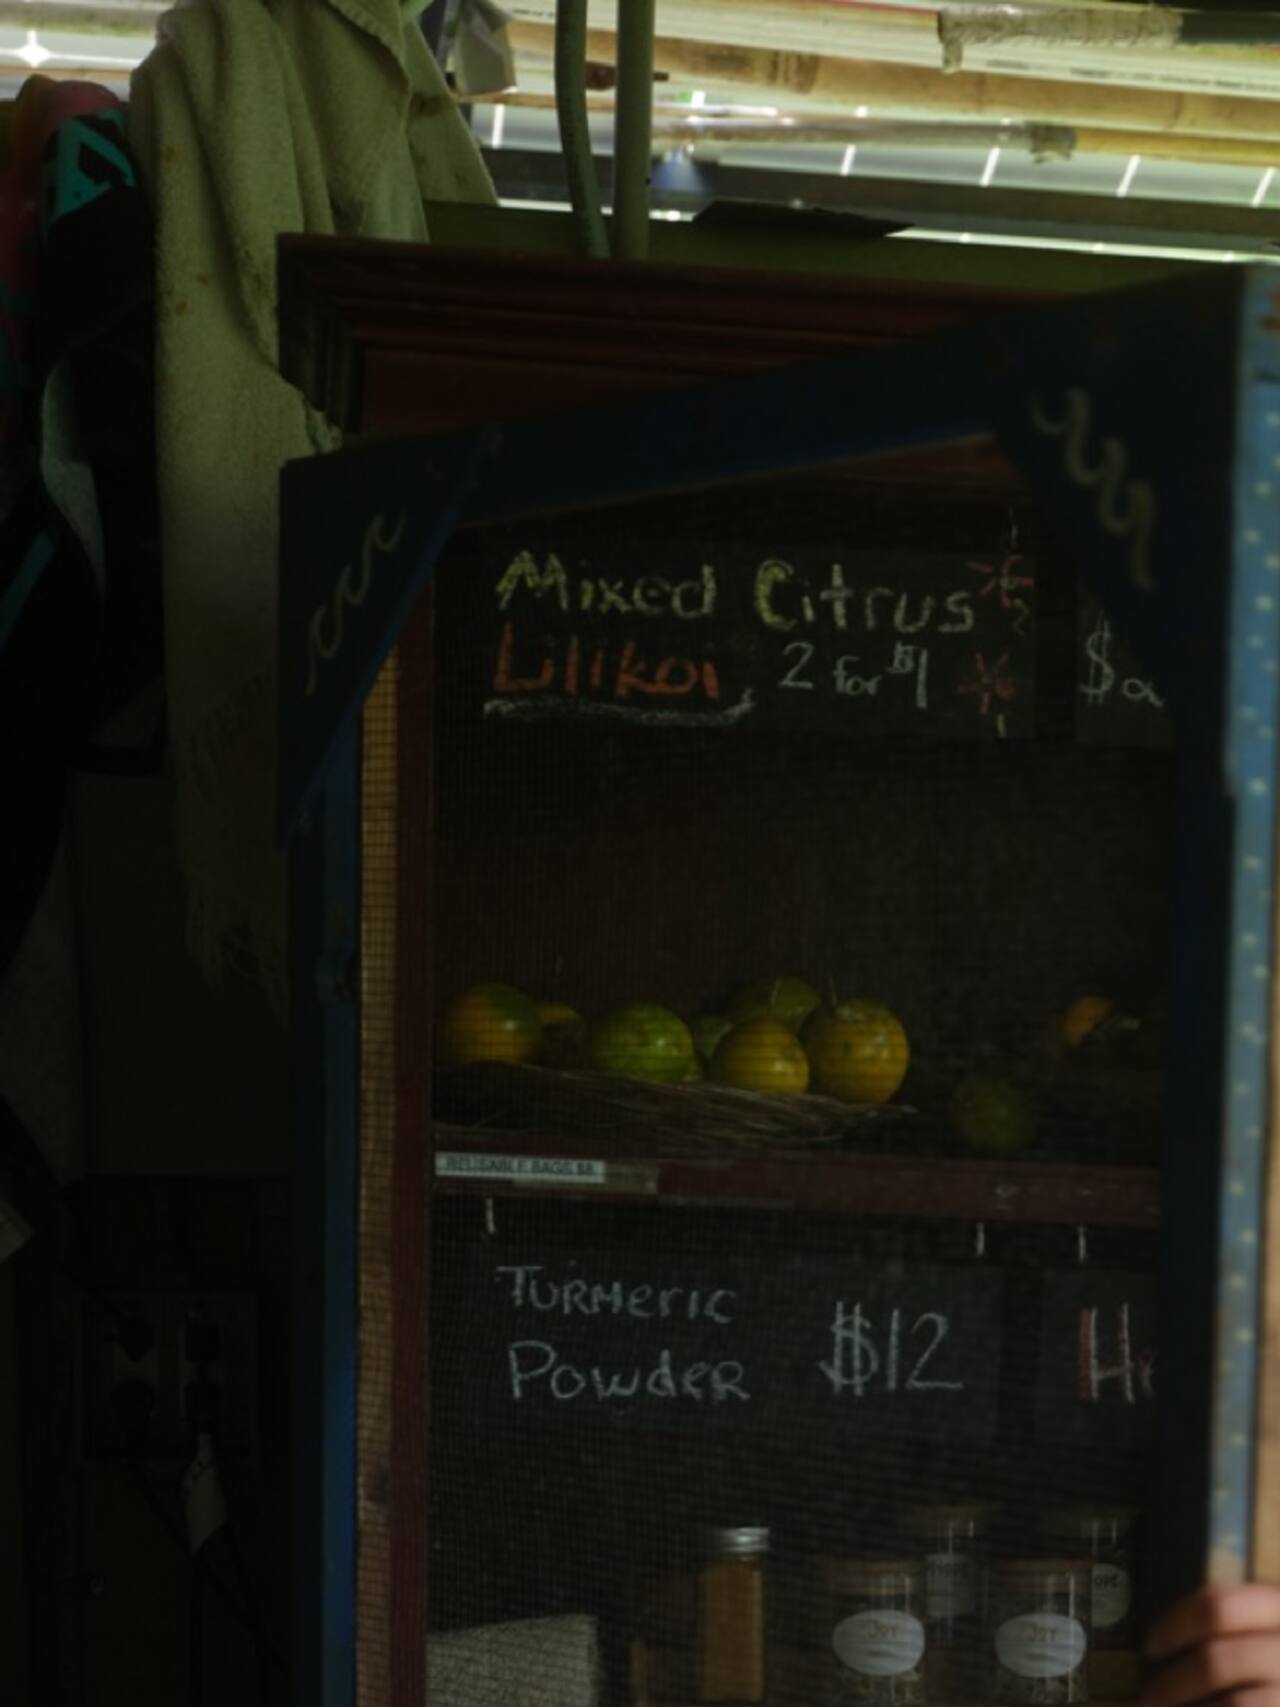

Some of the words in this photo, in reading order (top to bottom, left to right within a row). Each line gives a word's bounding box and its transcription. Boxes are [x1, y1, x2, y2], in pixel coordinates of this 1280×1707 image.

[496, 549, 715, 618] Mixed
[754, 557, 974, 633] Citrus
[779, 641, 814, 690] 2
[531, 1158, 573, 1176] BAGS
[818, 1300, 963, 1398] $12
